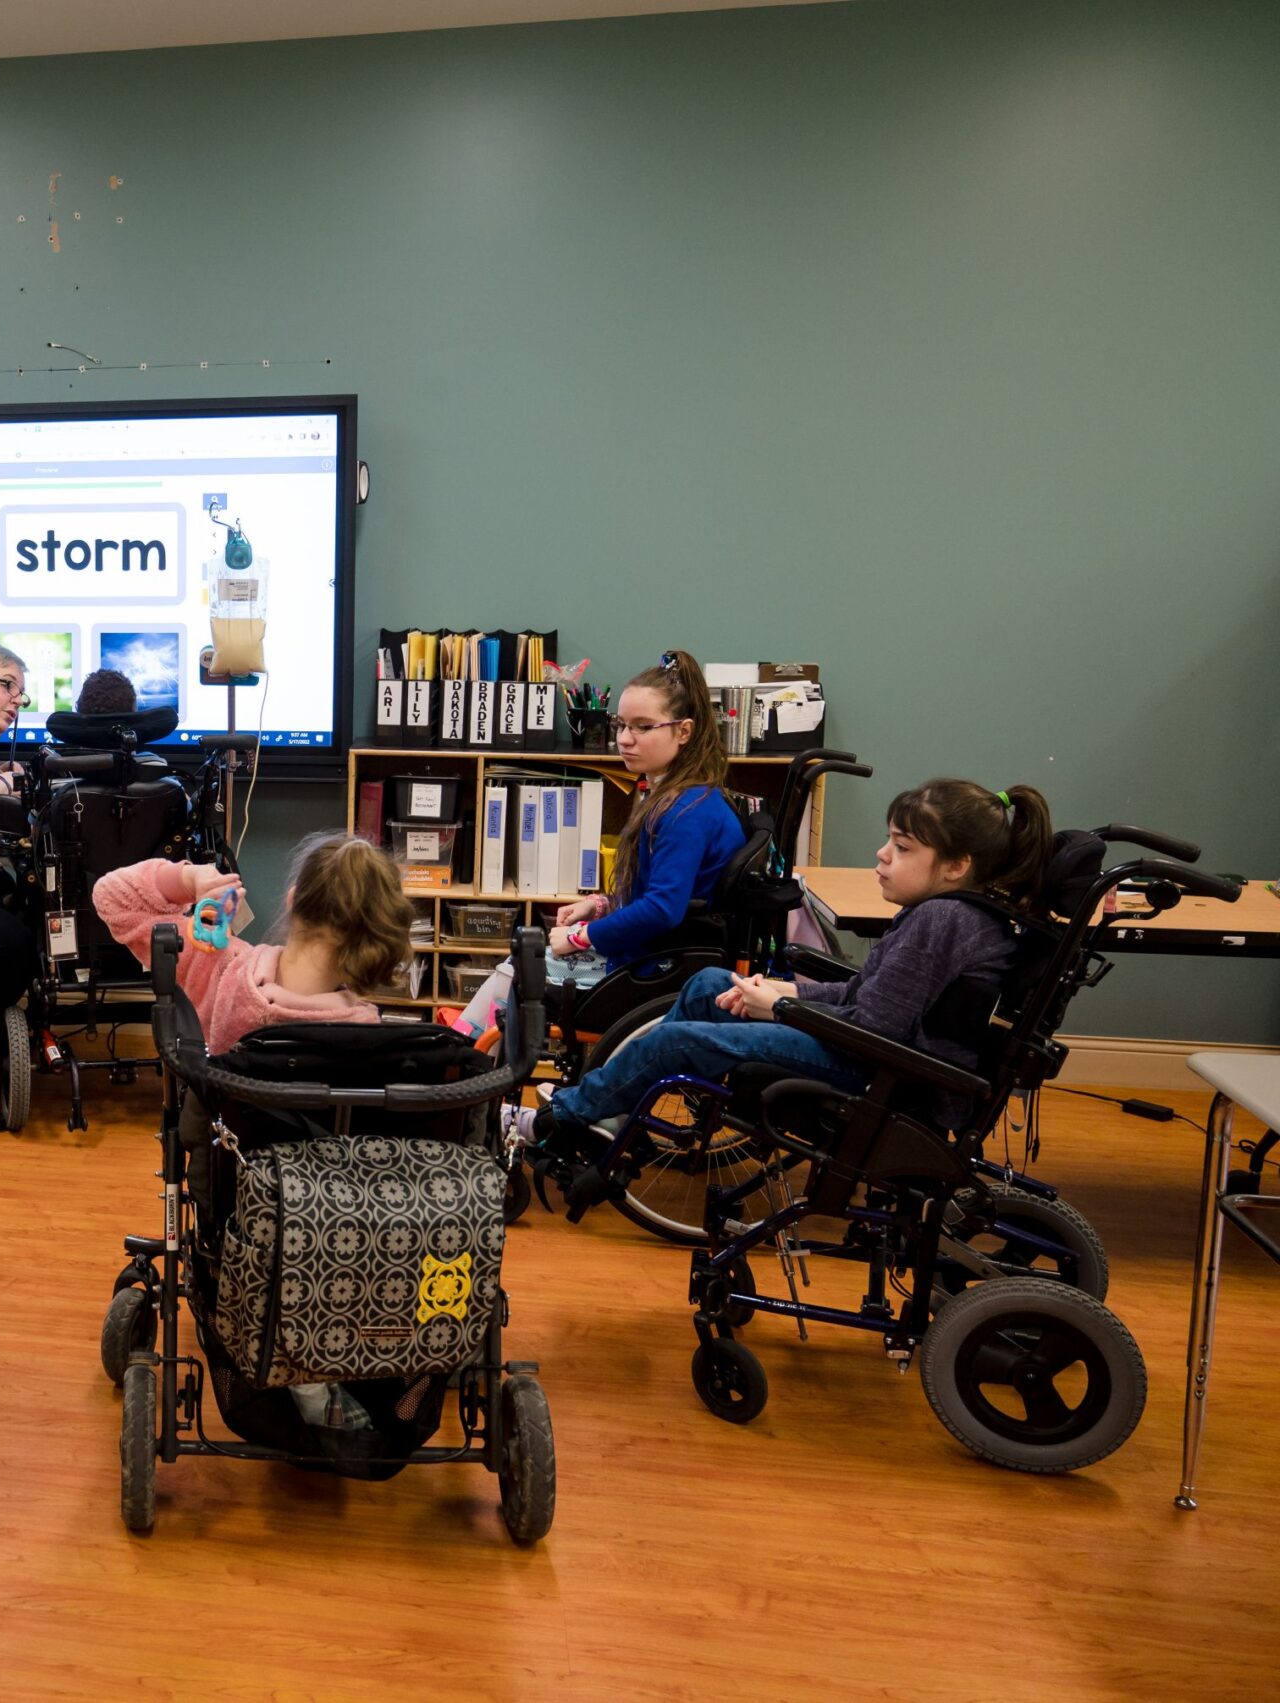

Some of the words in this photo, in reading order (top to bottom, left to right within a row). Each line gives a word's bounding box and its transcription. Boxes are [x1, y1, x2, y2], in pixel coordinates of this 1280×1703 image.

[17, 530, 166, 572] storm
[384, 686, 392, 718] ARI
[412, 681, 423, 723] LILY
[449, 681, 461, 739] DAKOTA
[477, 682, 488, 741] BRADEN
[505, 684, 516, 734] GRACE
[536, 685, 547, 726] MIKE
[545, 794, 554, 820] Dakota
[477, 924, 492, 933] bin
